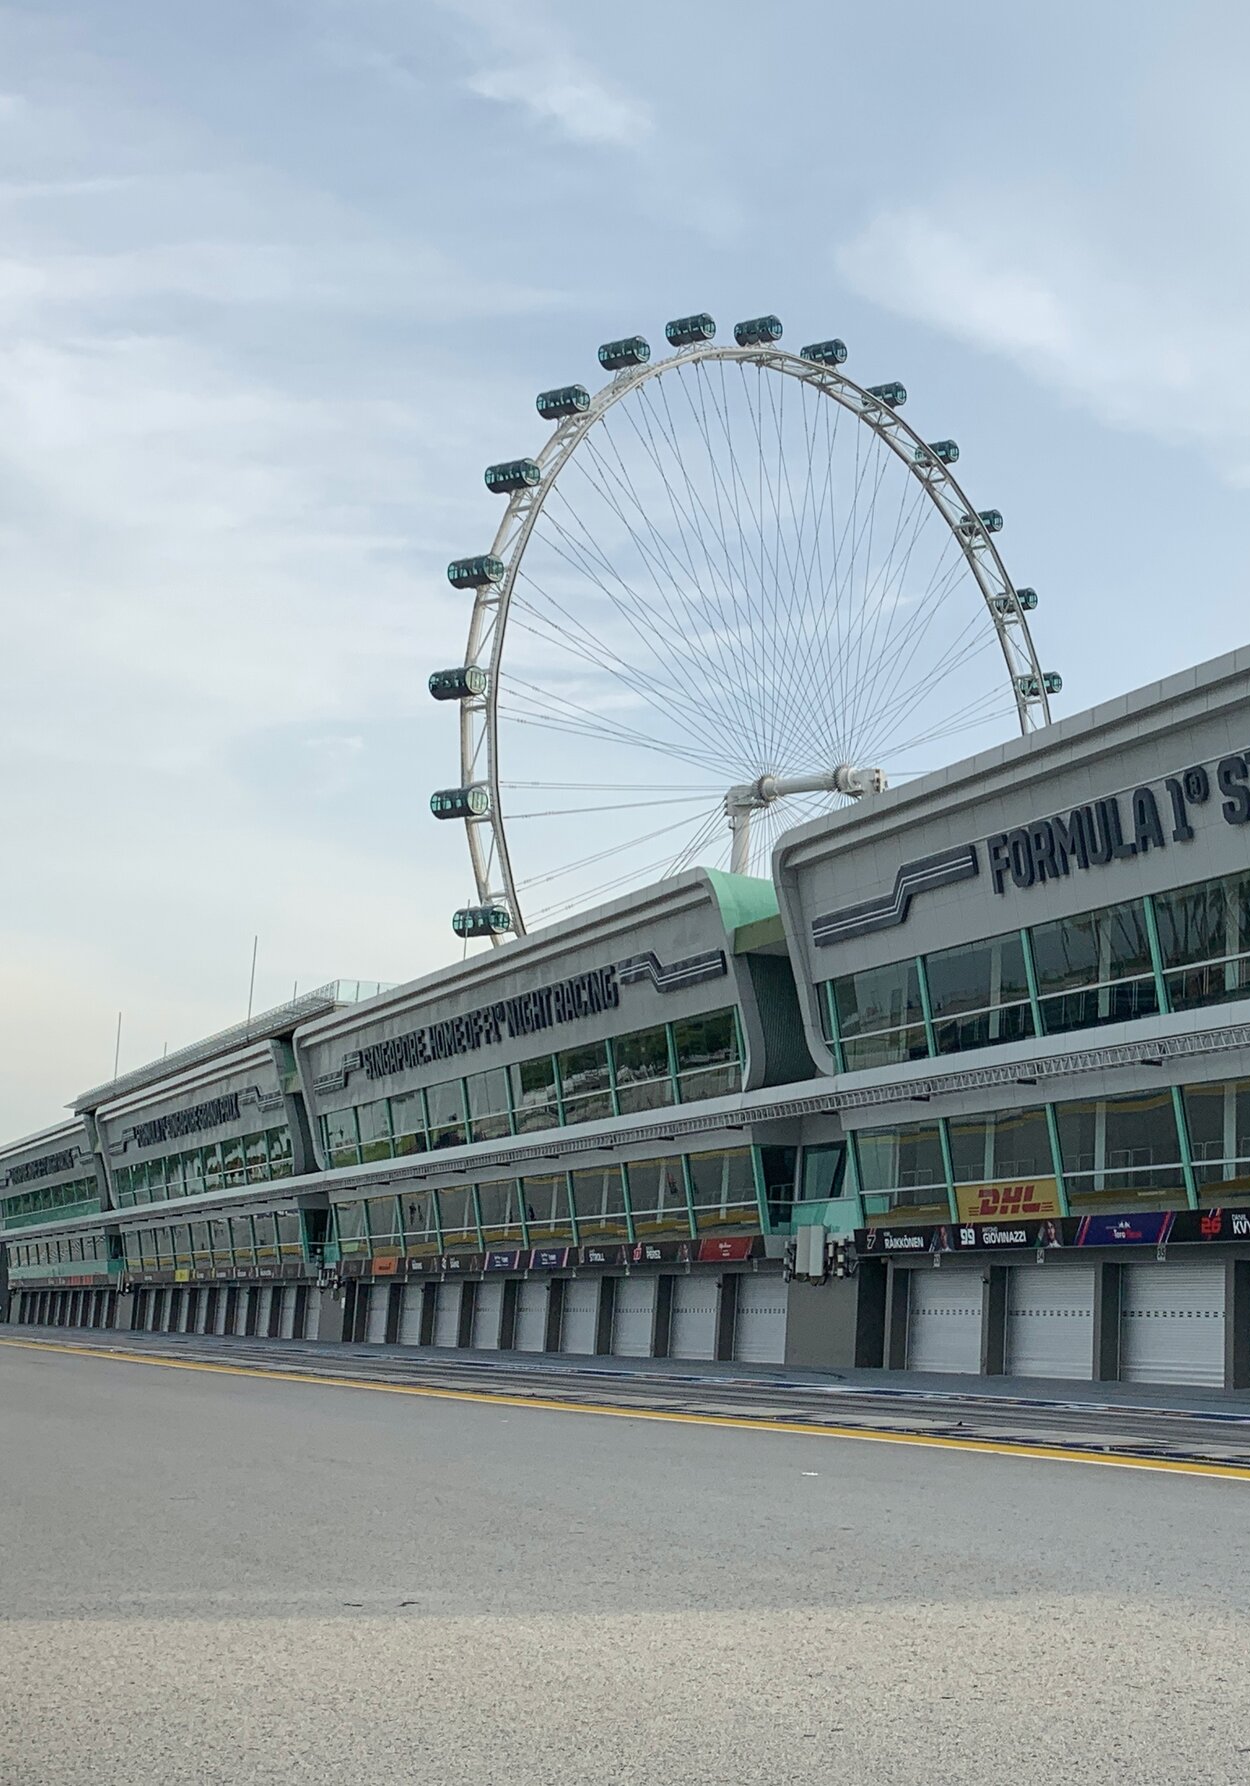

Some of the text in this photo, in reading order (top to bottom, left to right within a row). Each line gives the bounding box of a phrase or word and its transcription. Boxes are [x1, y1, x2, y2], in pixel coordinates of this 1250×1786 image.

[987, 787, 1166, 895] FORMULA
[429, 1016, 467, 1061] HOME
[505, 986, 554, 1038] NIGHT
[552, 965, 620, 1024] RACING
[978, 1185, 1042, 1216] DHL
[960, 1228, 976, 1246] 99
[982, 1229, 1027, 1245] GIOVINAZZI
[1201, 1216, 1222, 1234] 26
